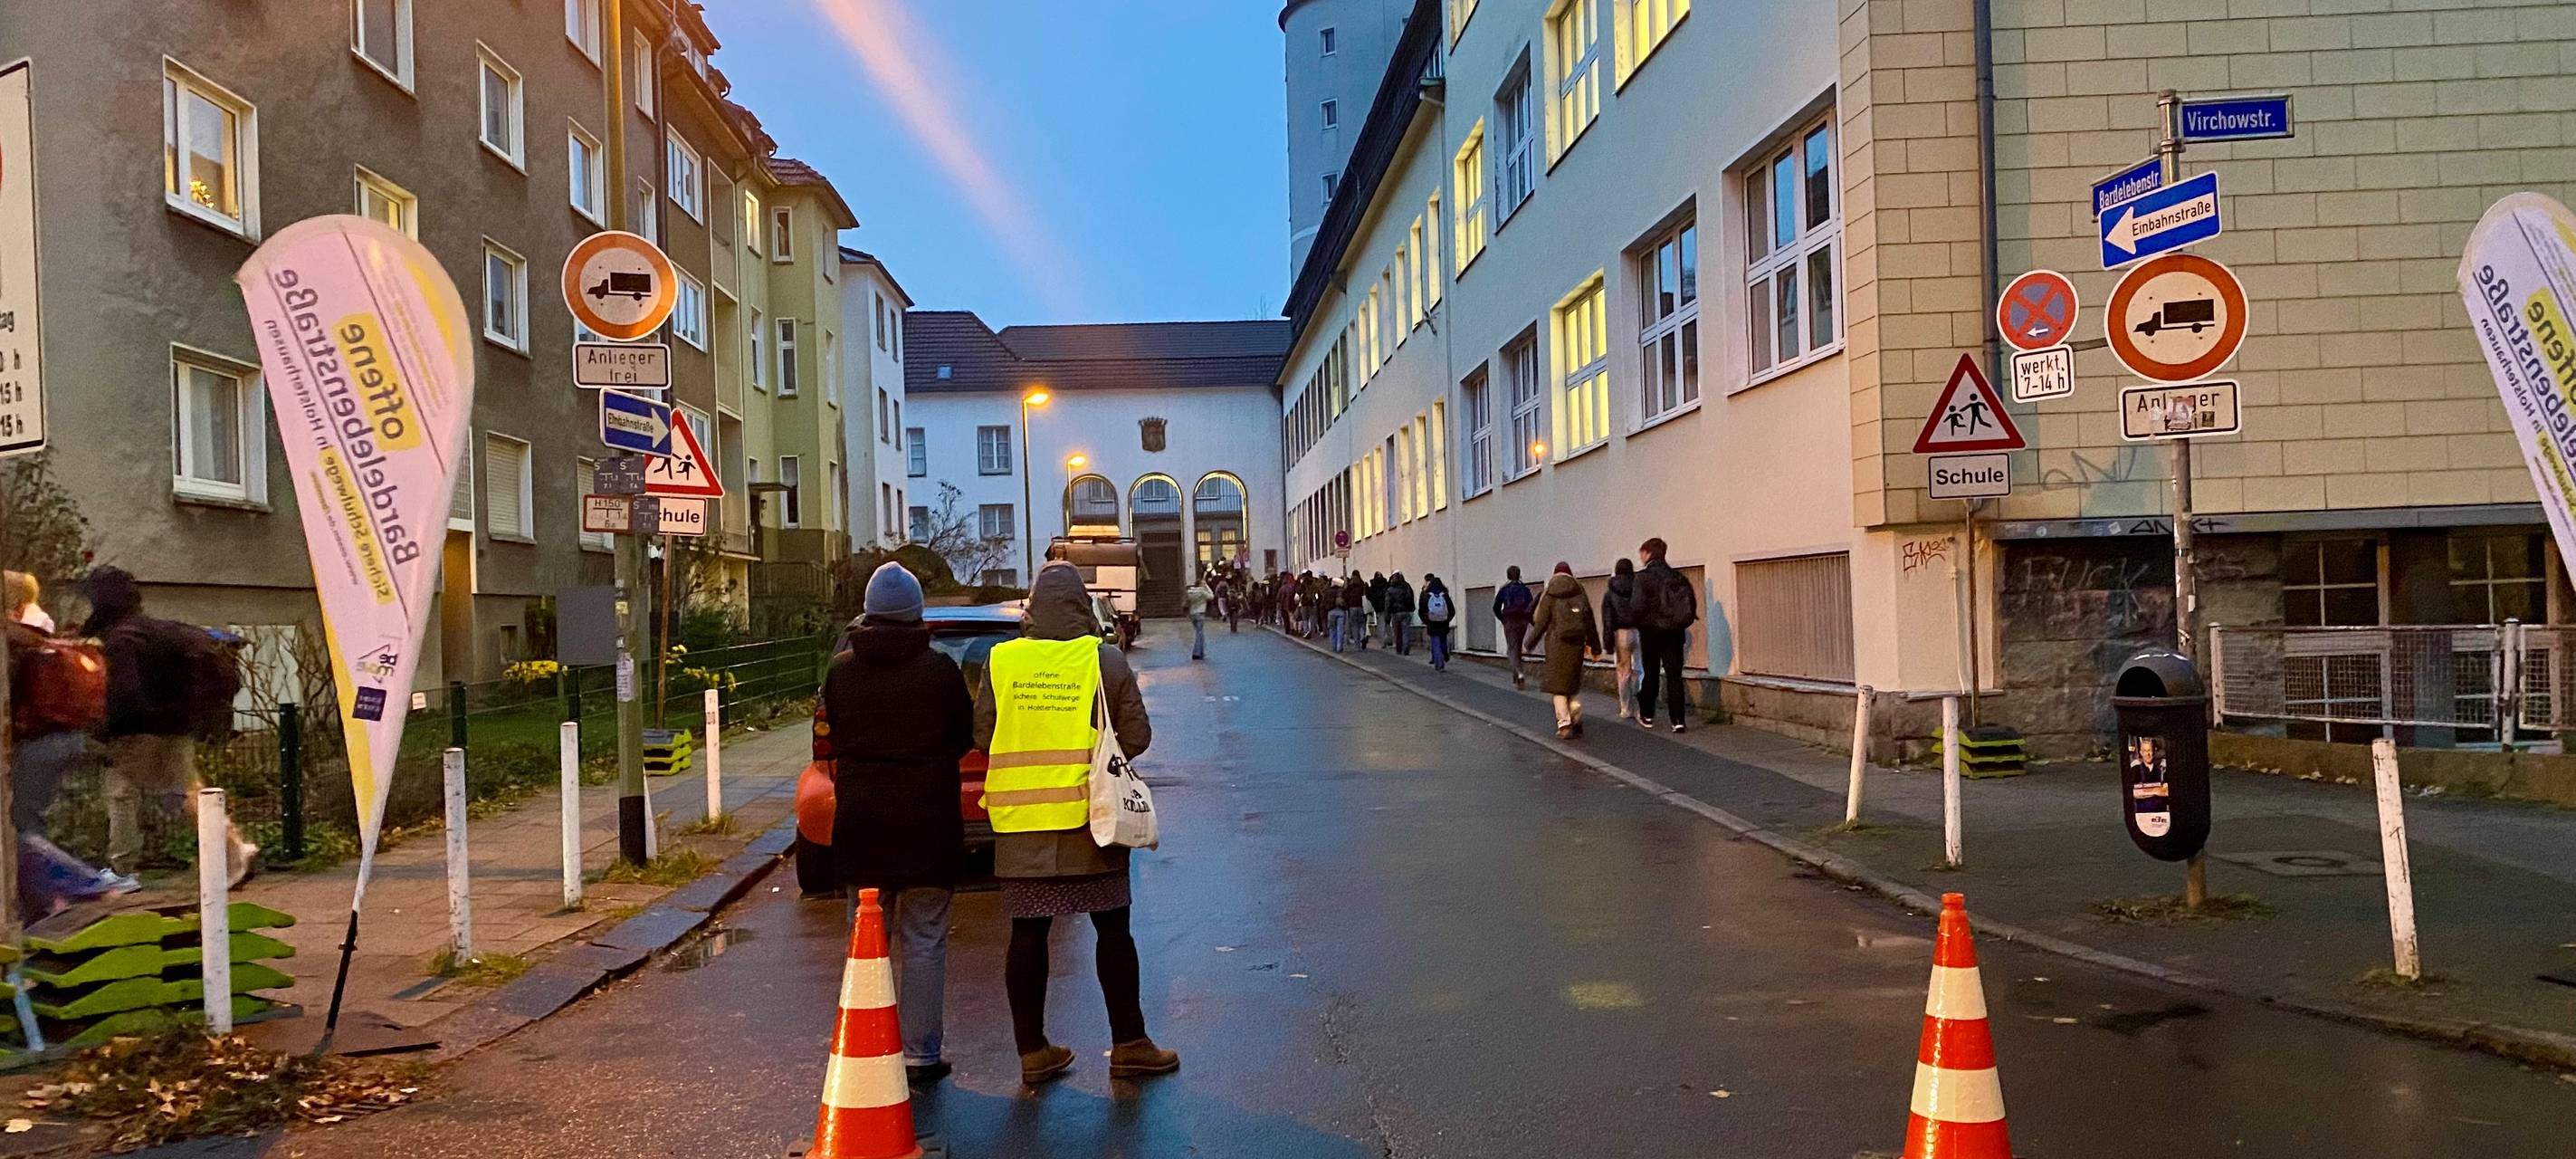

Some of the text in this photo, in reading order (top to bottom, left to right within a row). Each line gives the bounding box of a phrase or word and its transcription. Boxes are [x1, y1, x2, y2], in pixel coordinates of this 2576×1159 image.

[2187, 109, 2276, 131] Virchowstr.
[2132, 201, 2211, 236] Einbahnstraße
[587, 349, 655, 369] Anlieger
[2021, 355, 2065, 375] werkt.
[2024, 372, 2065, 394] 7-14 h
[607, 412, 654, 434] Einbahnstraße
[1936, 467, 2004, 485] Schule
[1012, 681, 1081, 690] Bardelebenstraße
